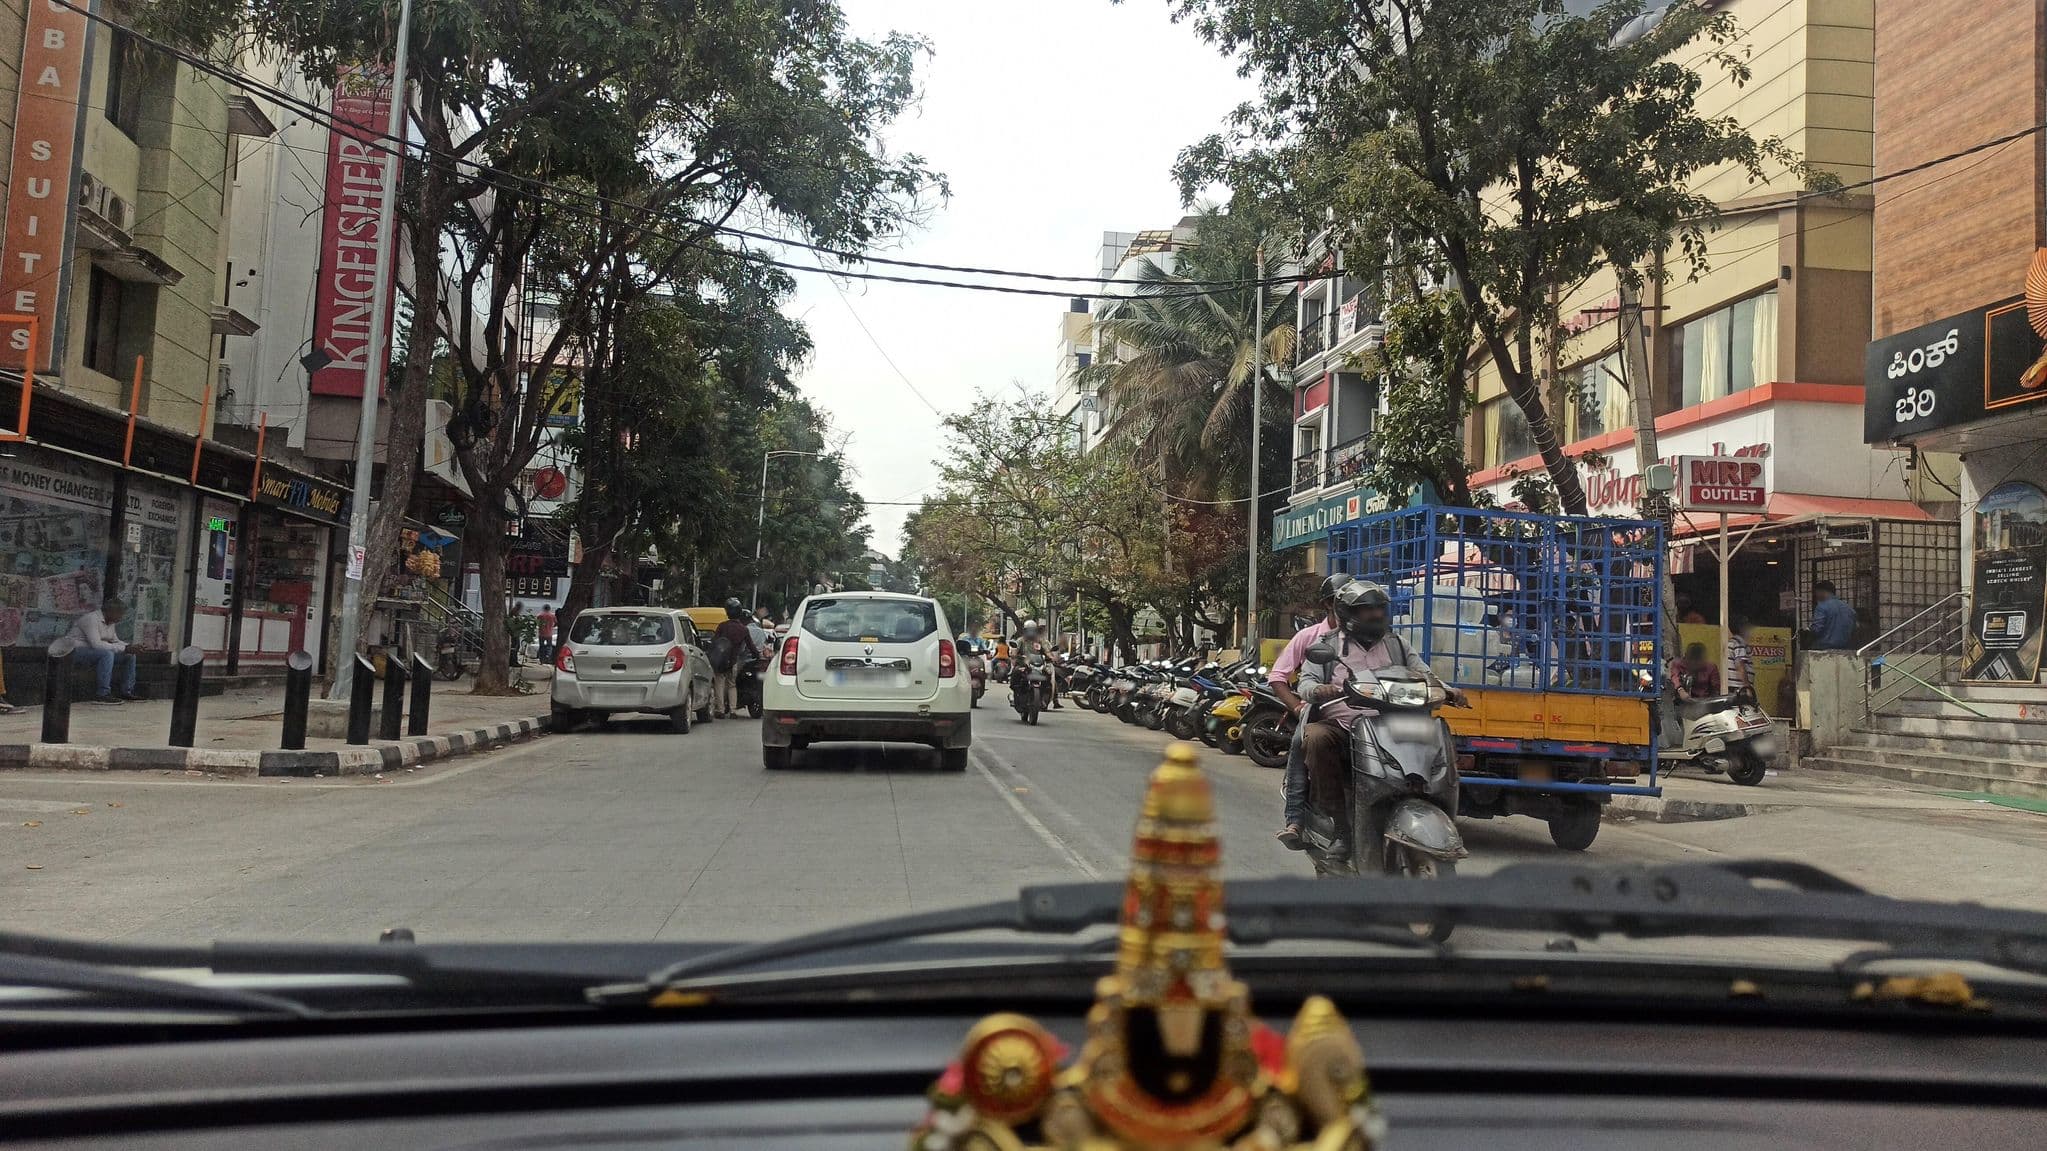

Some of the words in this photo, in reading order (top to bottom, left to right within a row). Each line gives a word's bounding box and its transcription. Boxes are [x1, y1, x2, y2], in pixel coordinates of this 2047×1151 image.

[9, 139, 52, 351] SUITES
[323, 136, 389, 371] KINGFISHER
[1887, 328, 1959, 379] ಪಿಂಕ್
[12, 469, 52, 491] MONEY
[258, 472, 291, 499] Smart
[1690, 460, 1762, 486] MRP
[1701, 488, 1757, 501] OUTLET
[1286, 514, 1315, 539] LINEN
[1316, 505, 1344, 530] CLUB
[2008, 565, 2033, 573] LARGEST
